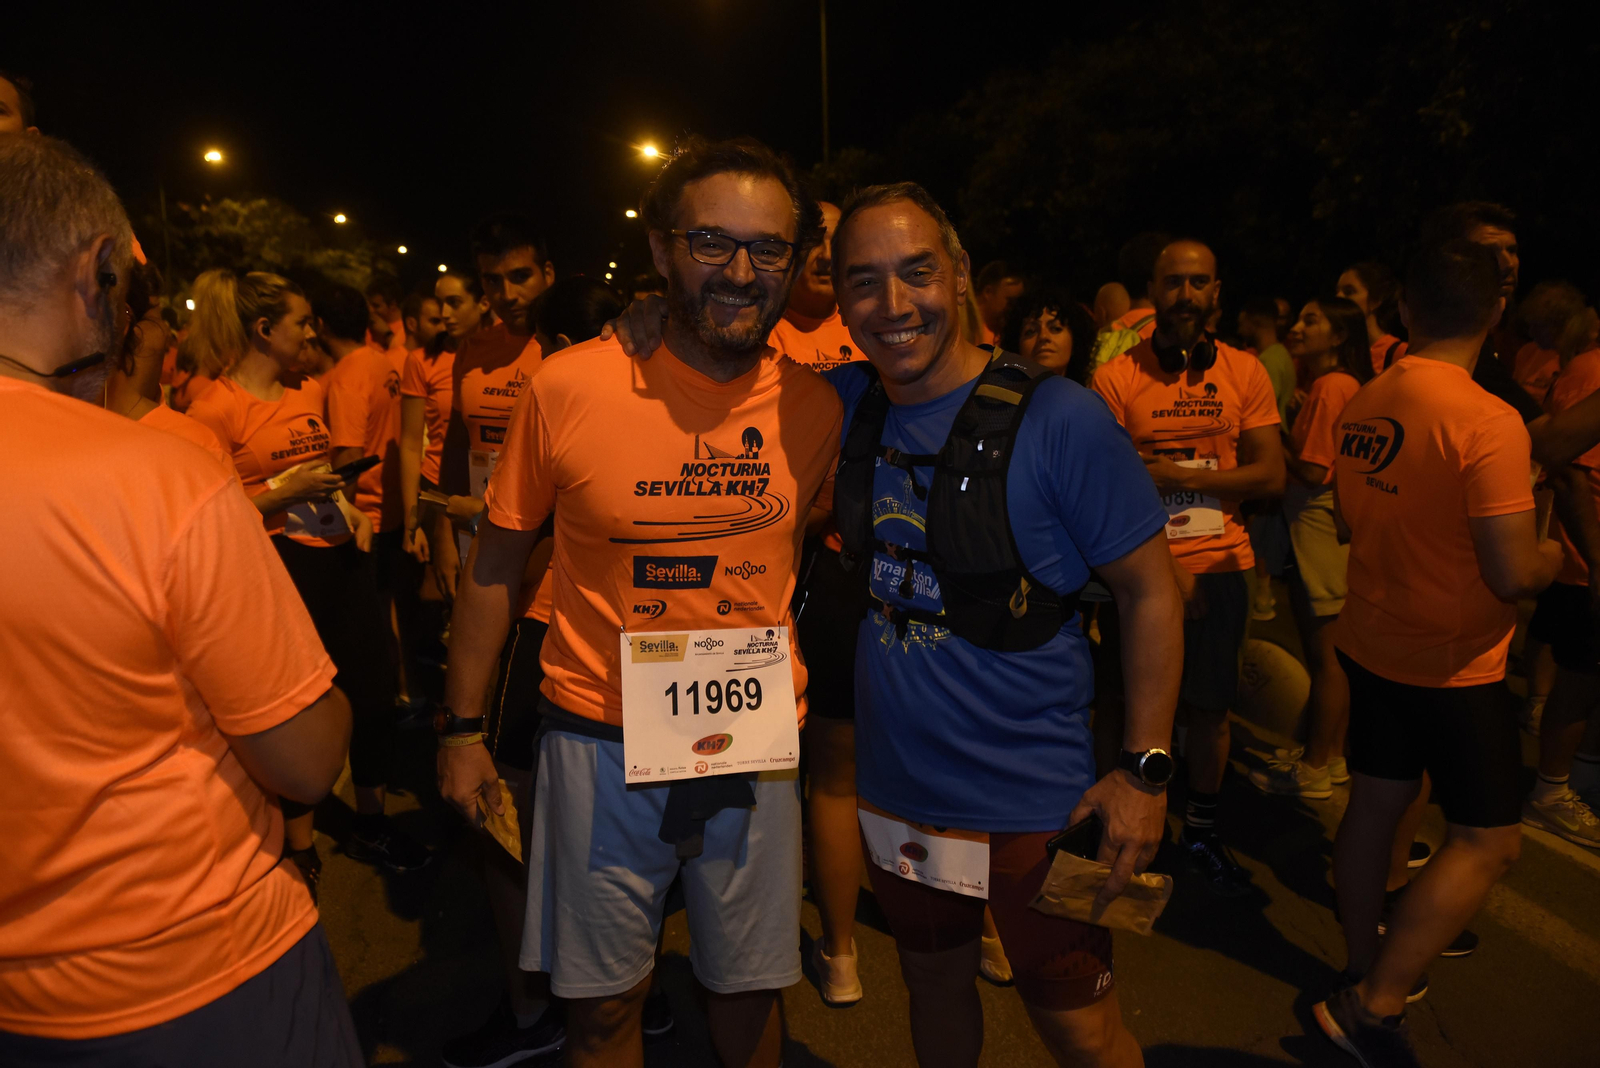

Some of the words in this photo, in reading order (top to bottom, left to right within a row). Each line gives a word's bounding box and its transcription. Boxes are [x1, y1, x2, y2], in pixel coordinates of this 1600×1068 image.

[1173, 400, 1224, 408] NOCTURNA
[1152, 408, 1197, 419] SEVILLA
[1341, 422, 1377, 434] NOCTURNA
[289, 433, 329, 447] NOCTURNA
[271, 443, 311, 461] SEVILLA
[680, 462, 771, 477] NOCTURNA
[633, 480, 723, 497] SEVILLA
[1365, 476, 1398, 495] SEVILLA
[734, 647, 761, 656] SEVILLA
[664, 677, 763, 716] 11969
